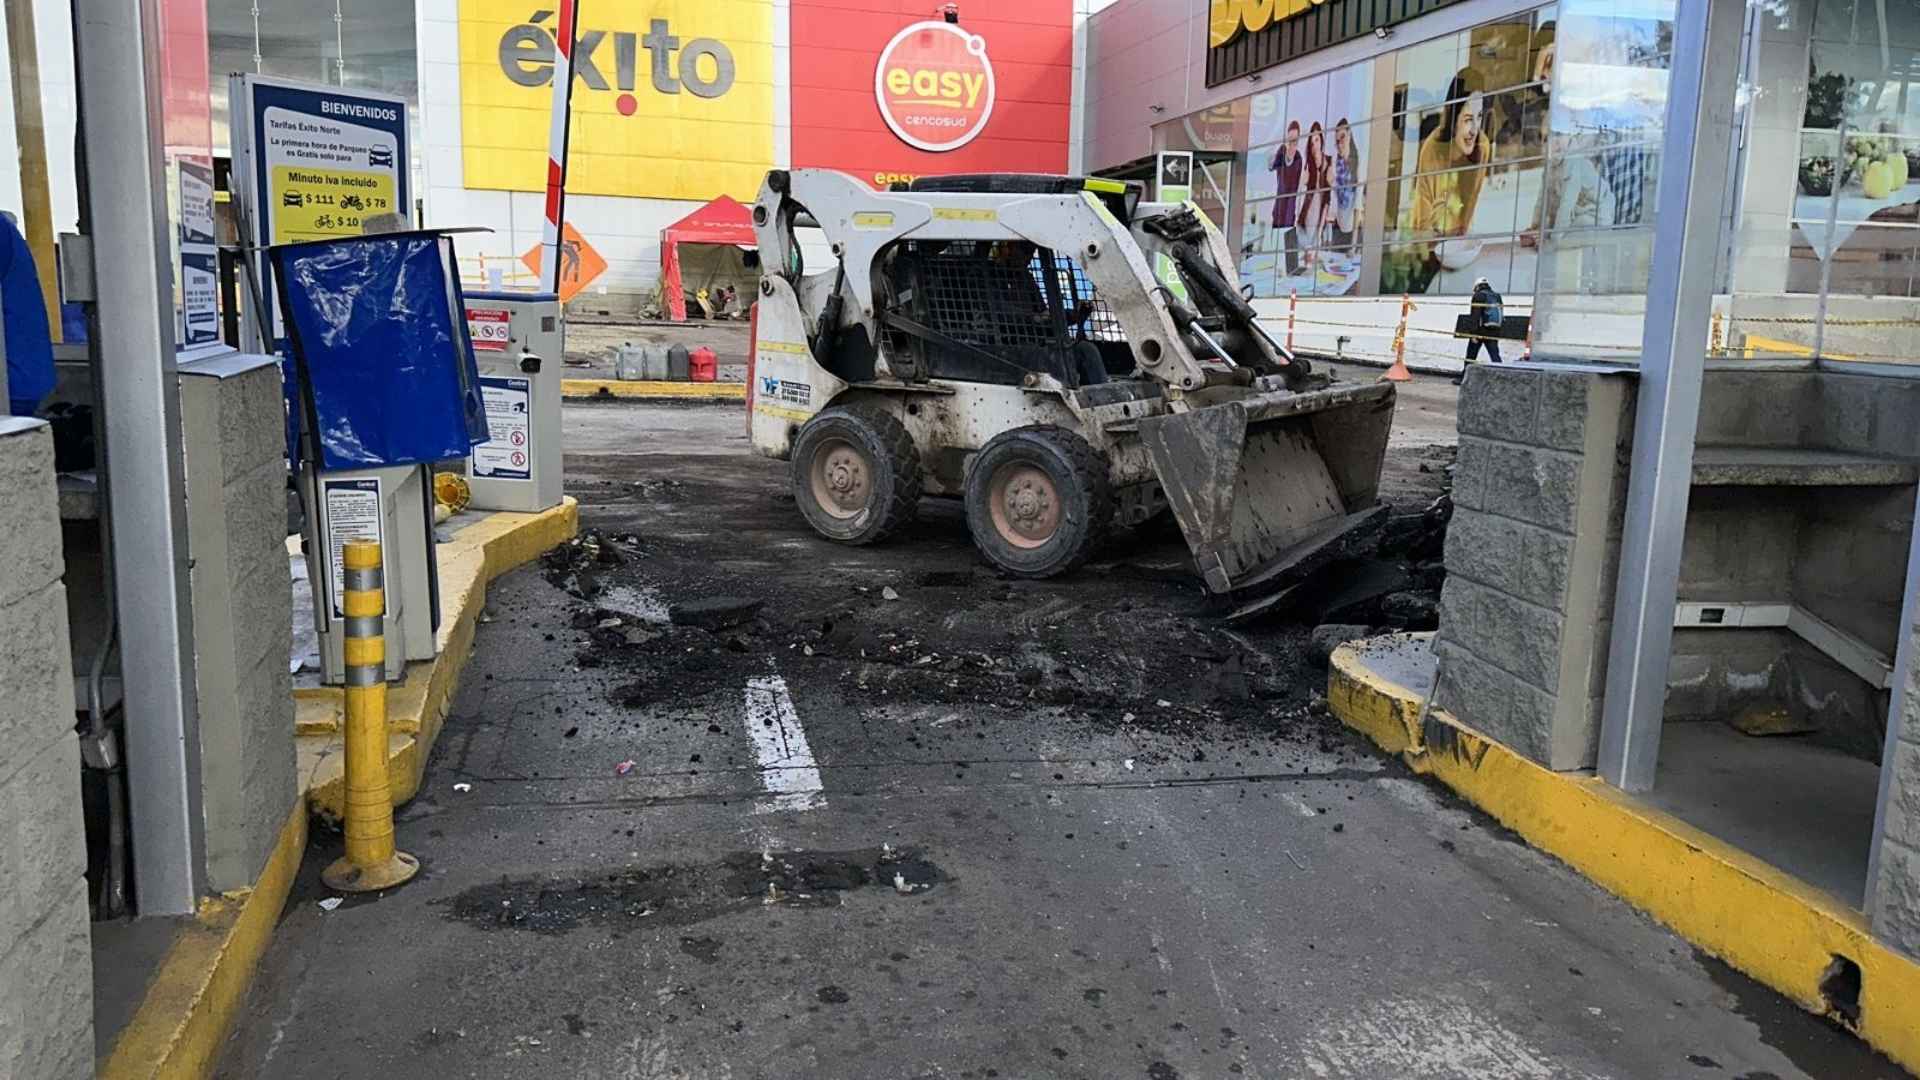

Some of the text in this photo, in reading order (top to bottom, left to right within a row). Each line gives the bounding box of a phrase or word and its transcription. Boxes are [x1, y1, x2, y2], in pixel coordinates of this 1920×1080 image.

[886, 67, 985, 109] easy
[321, 101, 397, 121] BIENVENIDOS
[270, 120, 297, 131] Tarifas
[320, 126, 341, 135] Norte
[904, 115, 967, 128] cencosud
[270, 137, 367, 154] La primera hora de Parqueo
[297, 150, 319, 159] Gratis
[320, 152, 335, 160] solo
[288, 172, 323, 184] Minuto
[341, 176, 378, 188] incluido
[305, 193, 387, 208] $ 111 $ 78
[337, 216, 344, 226] $
